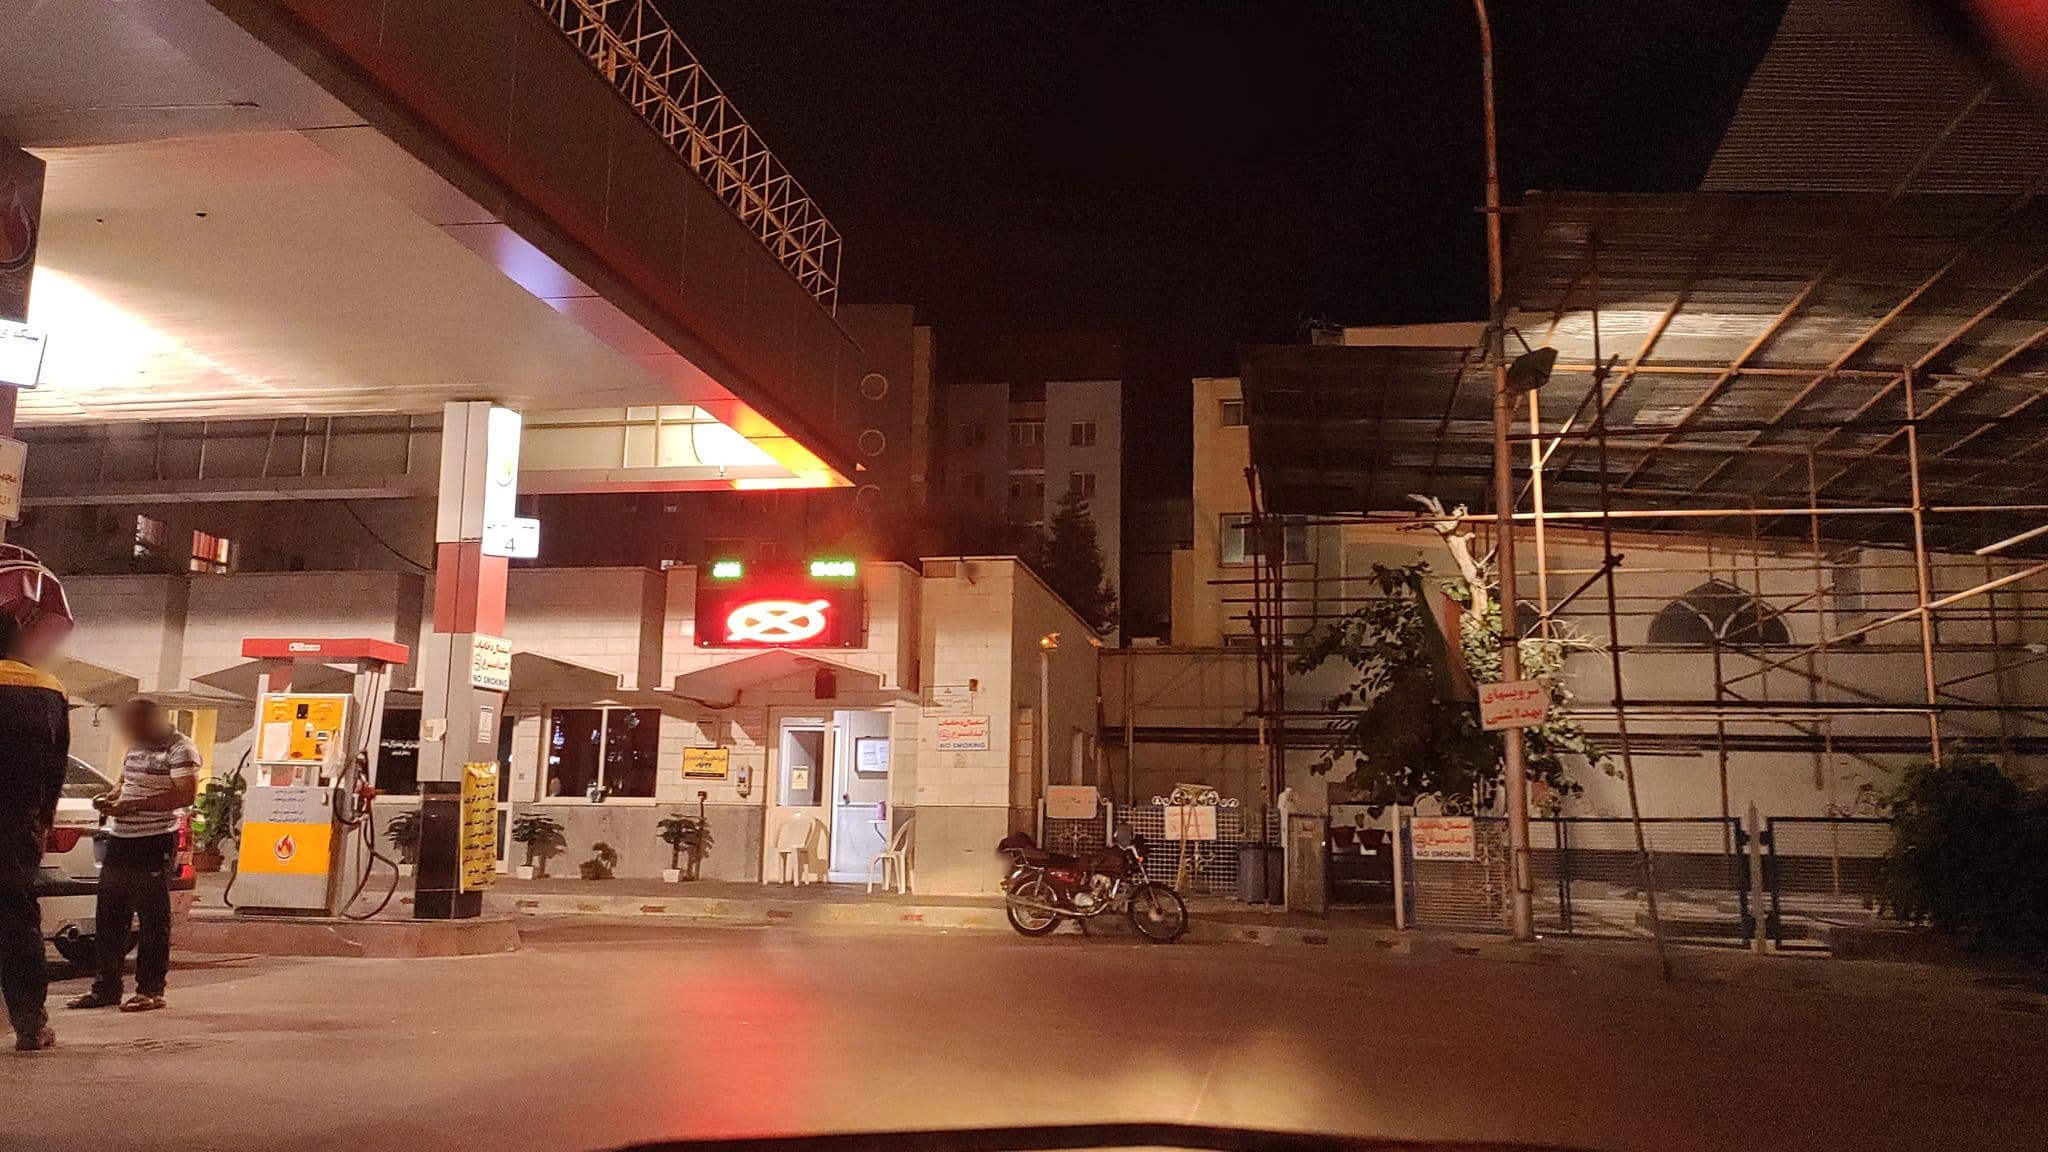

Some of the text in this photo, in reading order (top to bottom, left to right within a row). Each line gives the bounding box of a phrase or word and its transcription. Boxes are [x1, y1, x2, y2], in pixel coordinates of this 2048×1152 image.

[504, 537, 516, 552] 4
[473, 675, 482, 683] NO
[1486, 708, 1542, 725] بهداشتی
[1416, 850, 1472, 858] NO SMOKING
